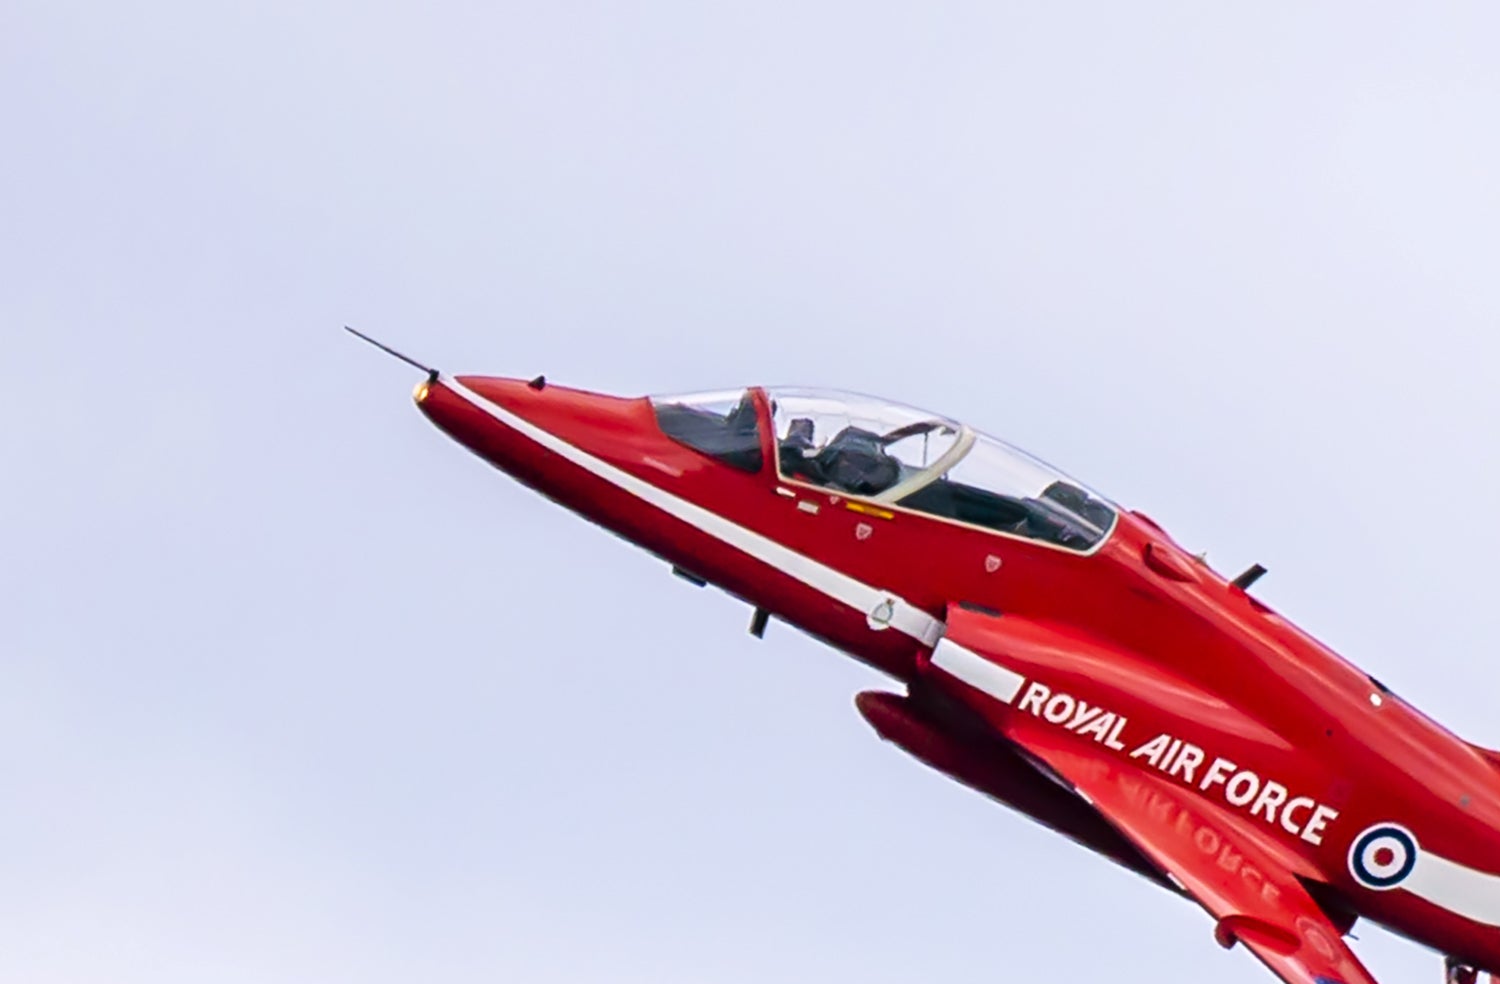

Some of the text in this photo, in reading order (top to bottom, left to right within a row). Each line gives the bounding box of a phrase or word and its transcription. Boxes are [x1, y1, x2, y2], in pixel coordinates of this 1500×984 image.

[1017, 681, 1339, 845] ROYAL AIR FORCE
